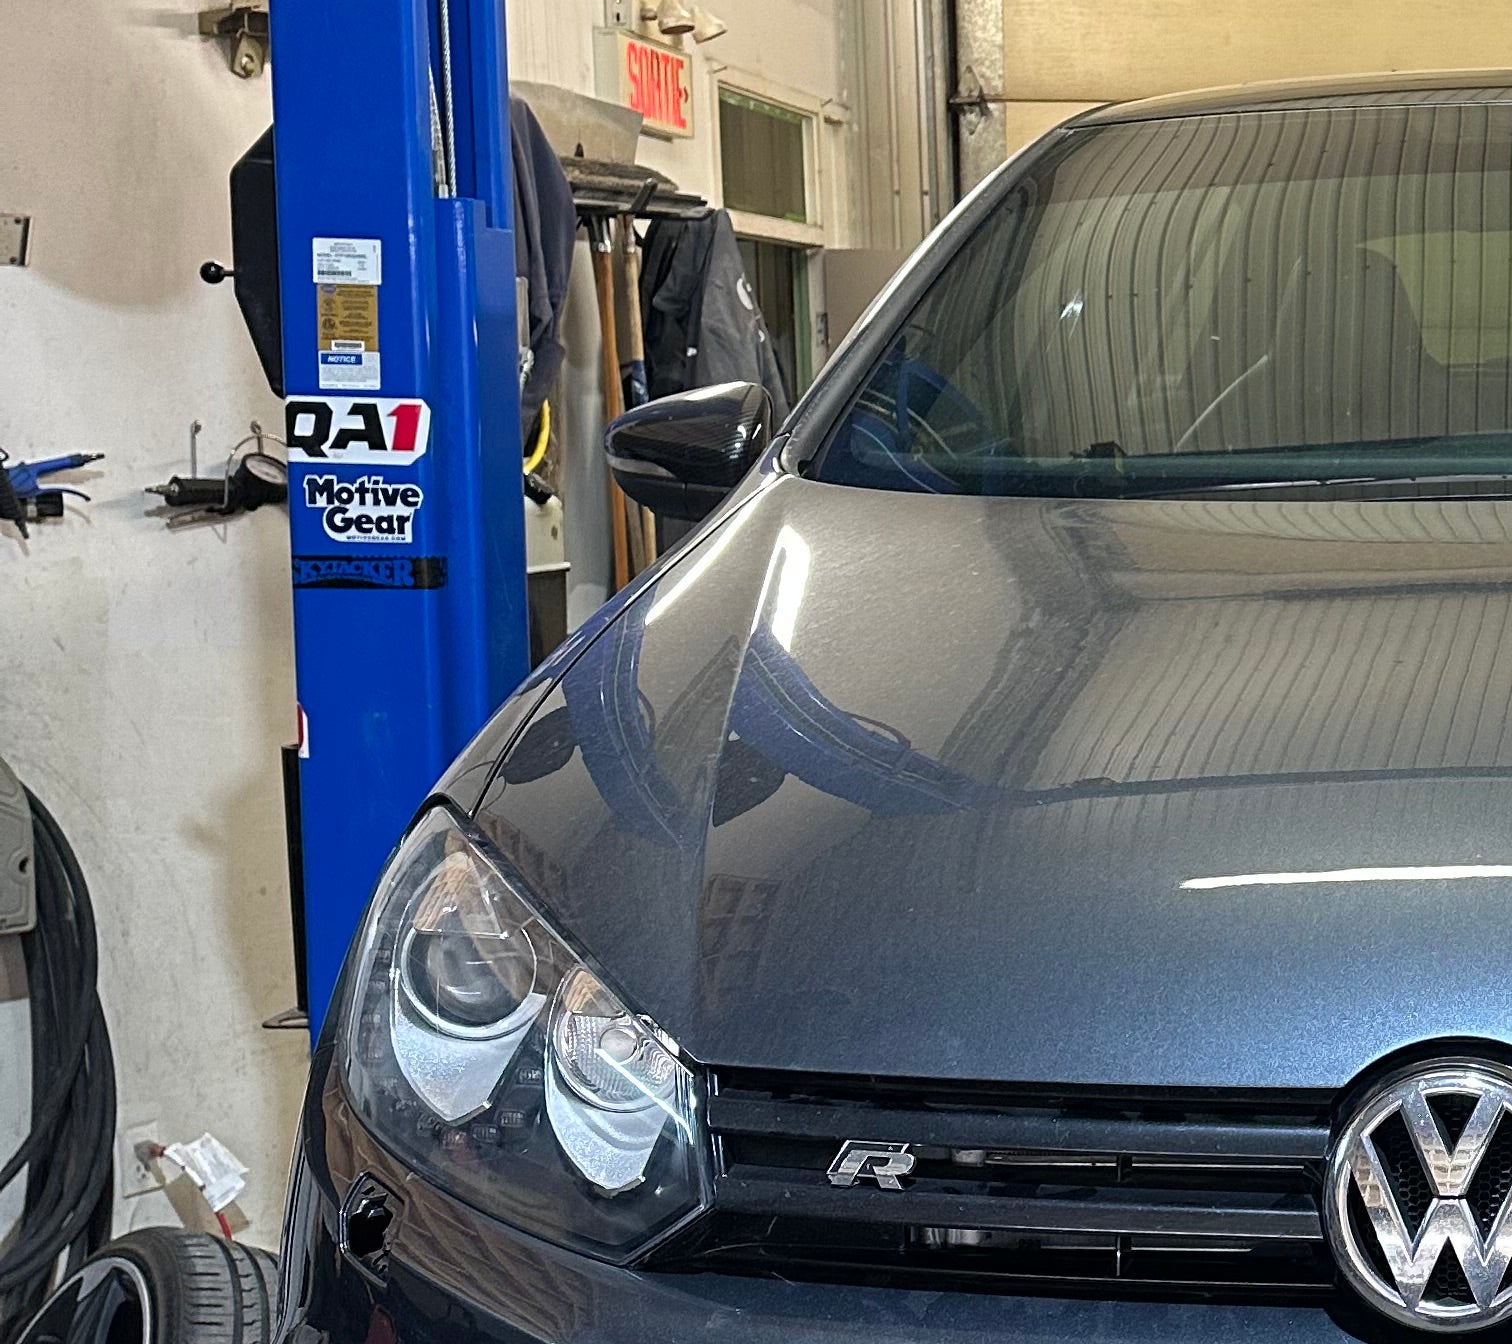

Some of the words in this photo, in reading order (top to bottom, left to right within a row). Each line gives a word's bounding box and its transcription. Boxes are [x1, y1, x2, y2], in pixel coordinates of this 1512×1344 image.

[627, 41, 687, 129] SORTIE
[286, 401, 422, 457] QA1
[306, 478, 420, 507] Motive
[326, 507, 412, 534] Gear
[826, 1140, 917, 1191] R
